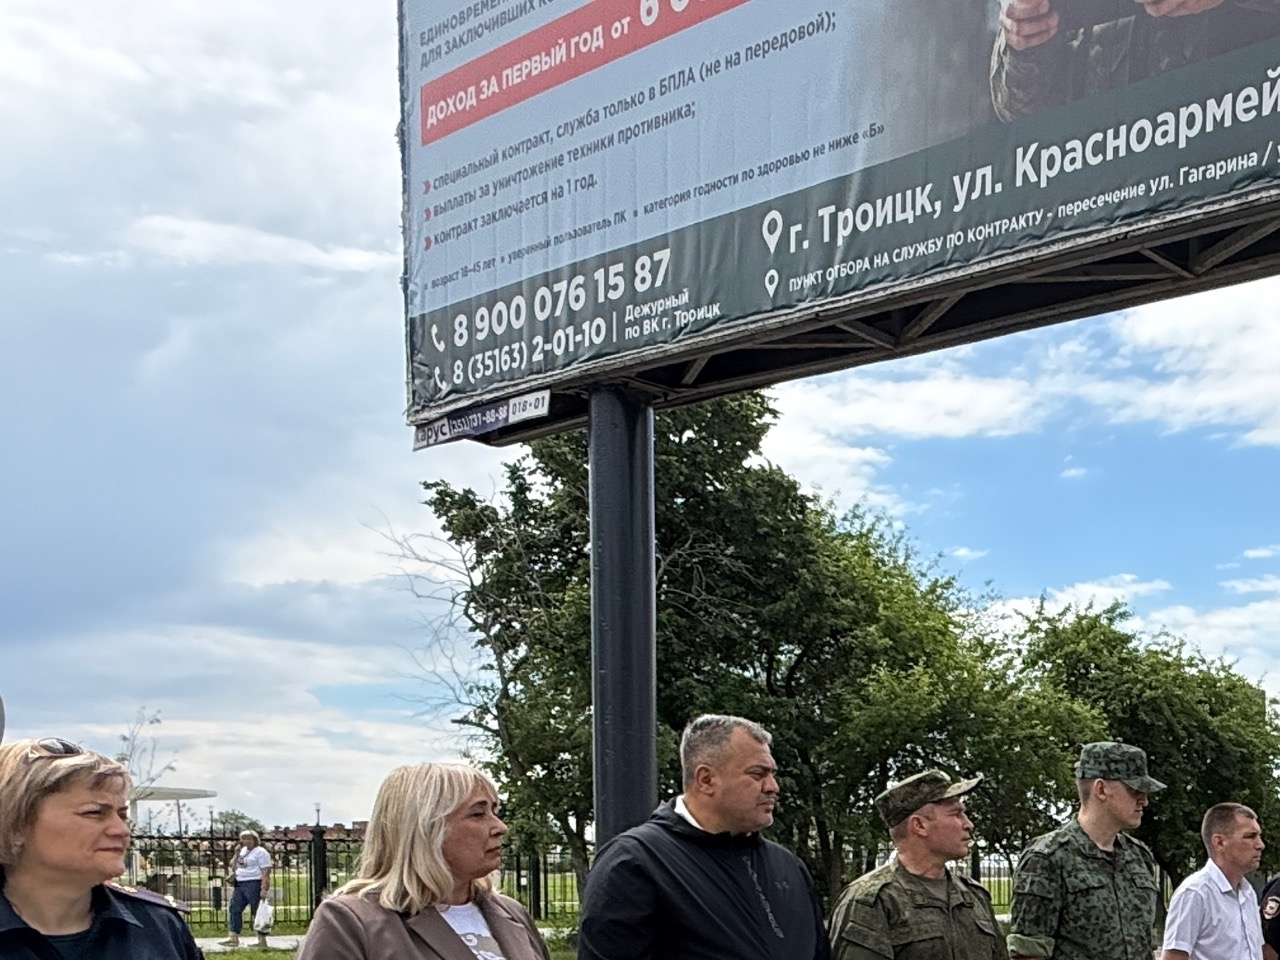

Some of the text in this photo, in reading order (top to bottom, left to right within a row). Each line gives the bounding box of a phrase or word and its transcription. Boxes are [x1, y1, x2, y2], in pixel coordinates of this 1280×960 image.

[420, 0, 536, 70] ДЛЯ ЗАКЛЮЧИВШИХ
[426, 85, 477, 129] ДОХОД
[479, 75, 500, 100] ЗА
[502, 38, 567, 90] ПЕРВЫЙ
[570, 25, 604, 58] ГОД
[610, 16, 631, 39] от
[433, 10, 836, 191] специальный контракт, служба только в БПЛА (не на передовой);
[433, 101, 696, 218] выплаты за уничтожение техники противника;
[553, 218, 612, 247] пользователь
[613, 209, 627, 228] ПК
[643, 189, 691, 217] категория
[693, 173, 739, 199] годности
[741, 167, 754, 183] по
[757, 148, 810, 179] здоровью
[812, 143, 826, 158] не
[828, 132, 859, 153] ниже
[433, 172, 598, 247] контракт заключается на 1 год.
[788, 268, 823, 292] ПУНКТ
[826, 259, 870, 283] ОТБОРА
[873, 251, 890, 269] НА
[893, 238, 943, 264] СЛУЖБУ
[946, 230, 965, 250] ПО
[967, 209, 1043, 243] КОНТРАКТУ
[1058, 181, 1146, 219] пересечение
[1149, 176, 1174, 206] ул.
[1179, 149, 1258, 186] Гагарина
[789, 222, 809, 253] г.
[818, 182, 942, 248] Троицк,
[952, 164, 1003, 213] ул.
[453, 247, 671, 347] 8 900 076 15 87
[624, 287, 689, 323] Дежурный
[624, 302, 721, 341] по ВК г. Троицк
[453, 317, 606, 386] 8 (35163) 2-01-10
